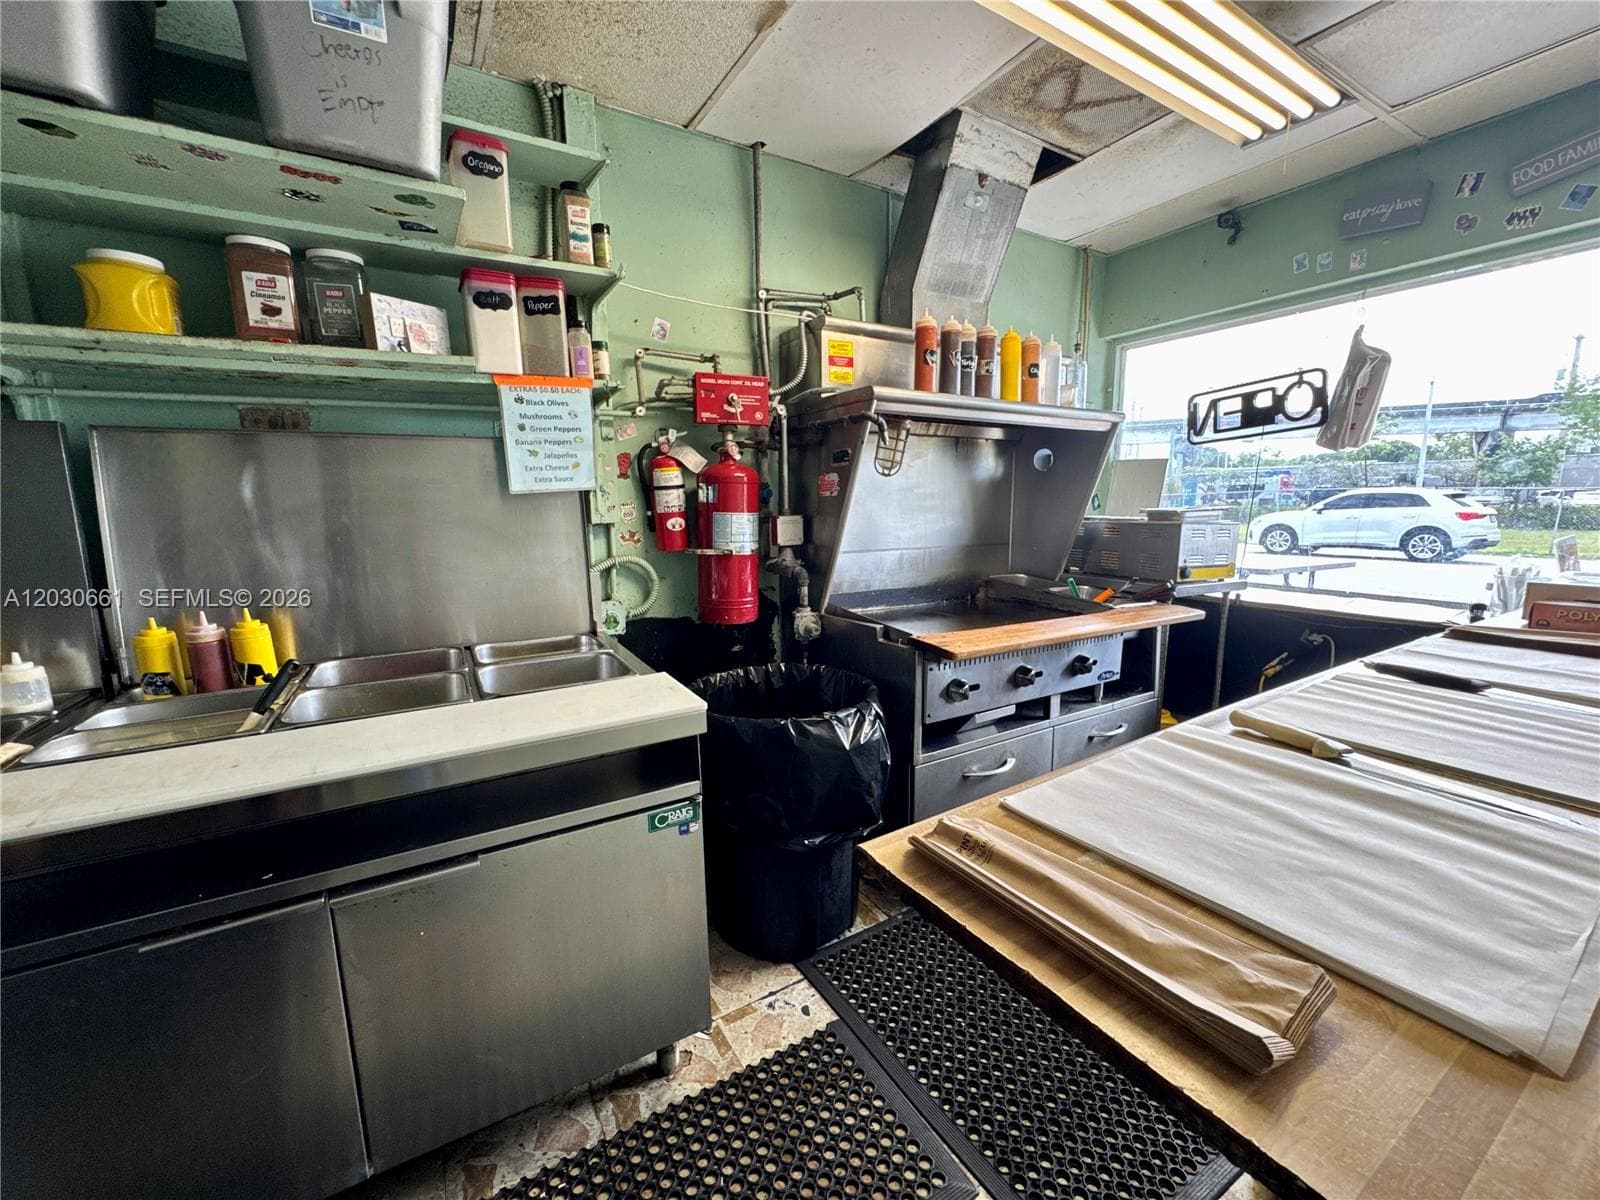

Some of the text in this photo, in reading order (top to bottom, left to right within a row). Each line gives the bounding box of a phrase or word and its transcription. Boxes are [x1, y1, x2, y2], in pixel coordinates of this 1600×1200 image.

[467, 156, 502, 173] Oregano
[1511, 158, 1555, 185] FOOD
[1395, 198, 1423, 211] love
[250, 290, 286, 301] Cinnamon
[322, 306, 353, 315] PEPPER
[527, 300, 555, 311] Pepper
[525, 399, 569, 407] Black Olives
[519, 412, 563, 420] Mushrooms
[529, 425, 582, 434] Green Peppers
[543, 438, 573, 447] Peppers
[524, 464, 543, 472] Extra
[654, 806, 694, 828] CRAIG
